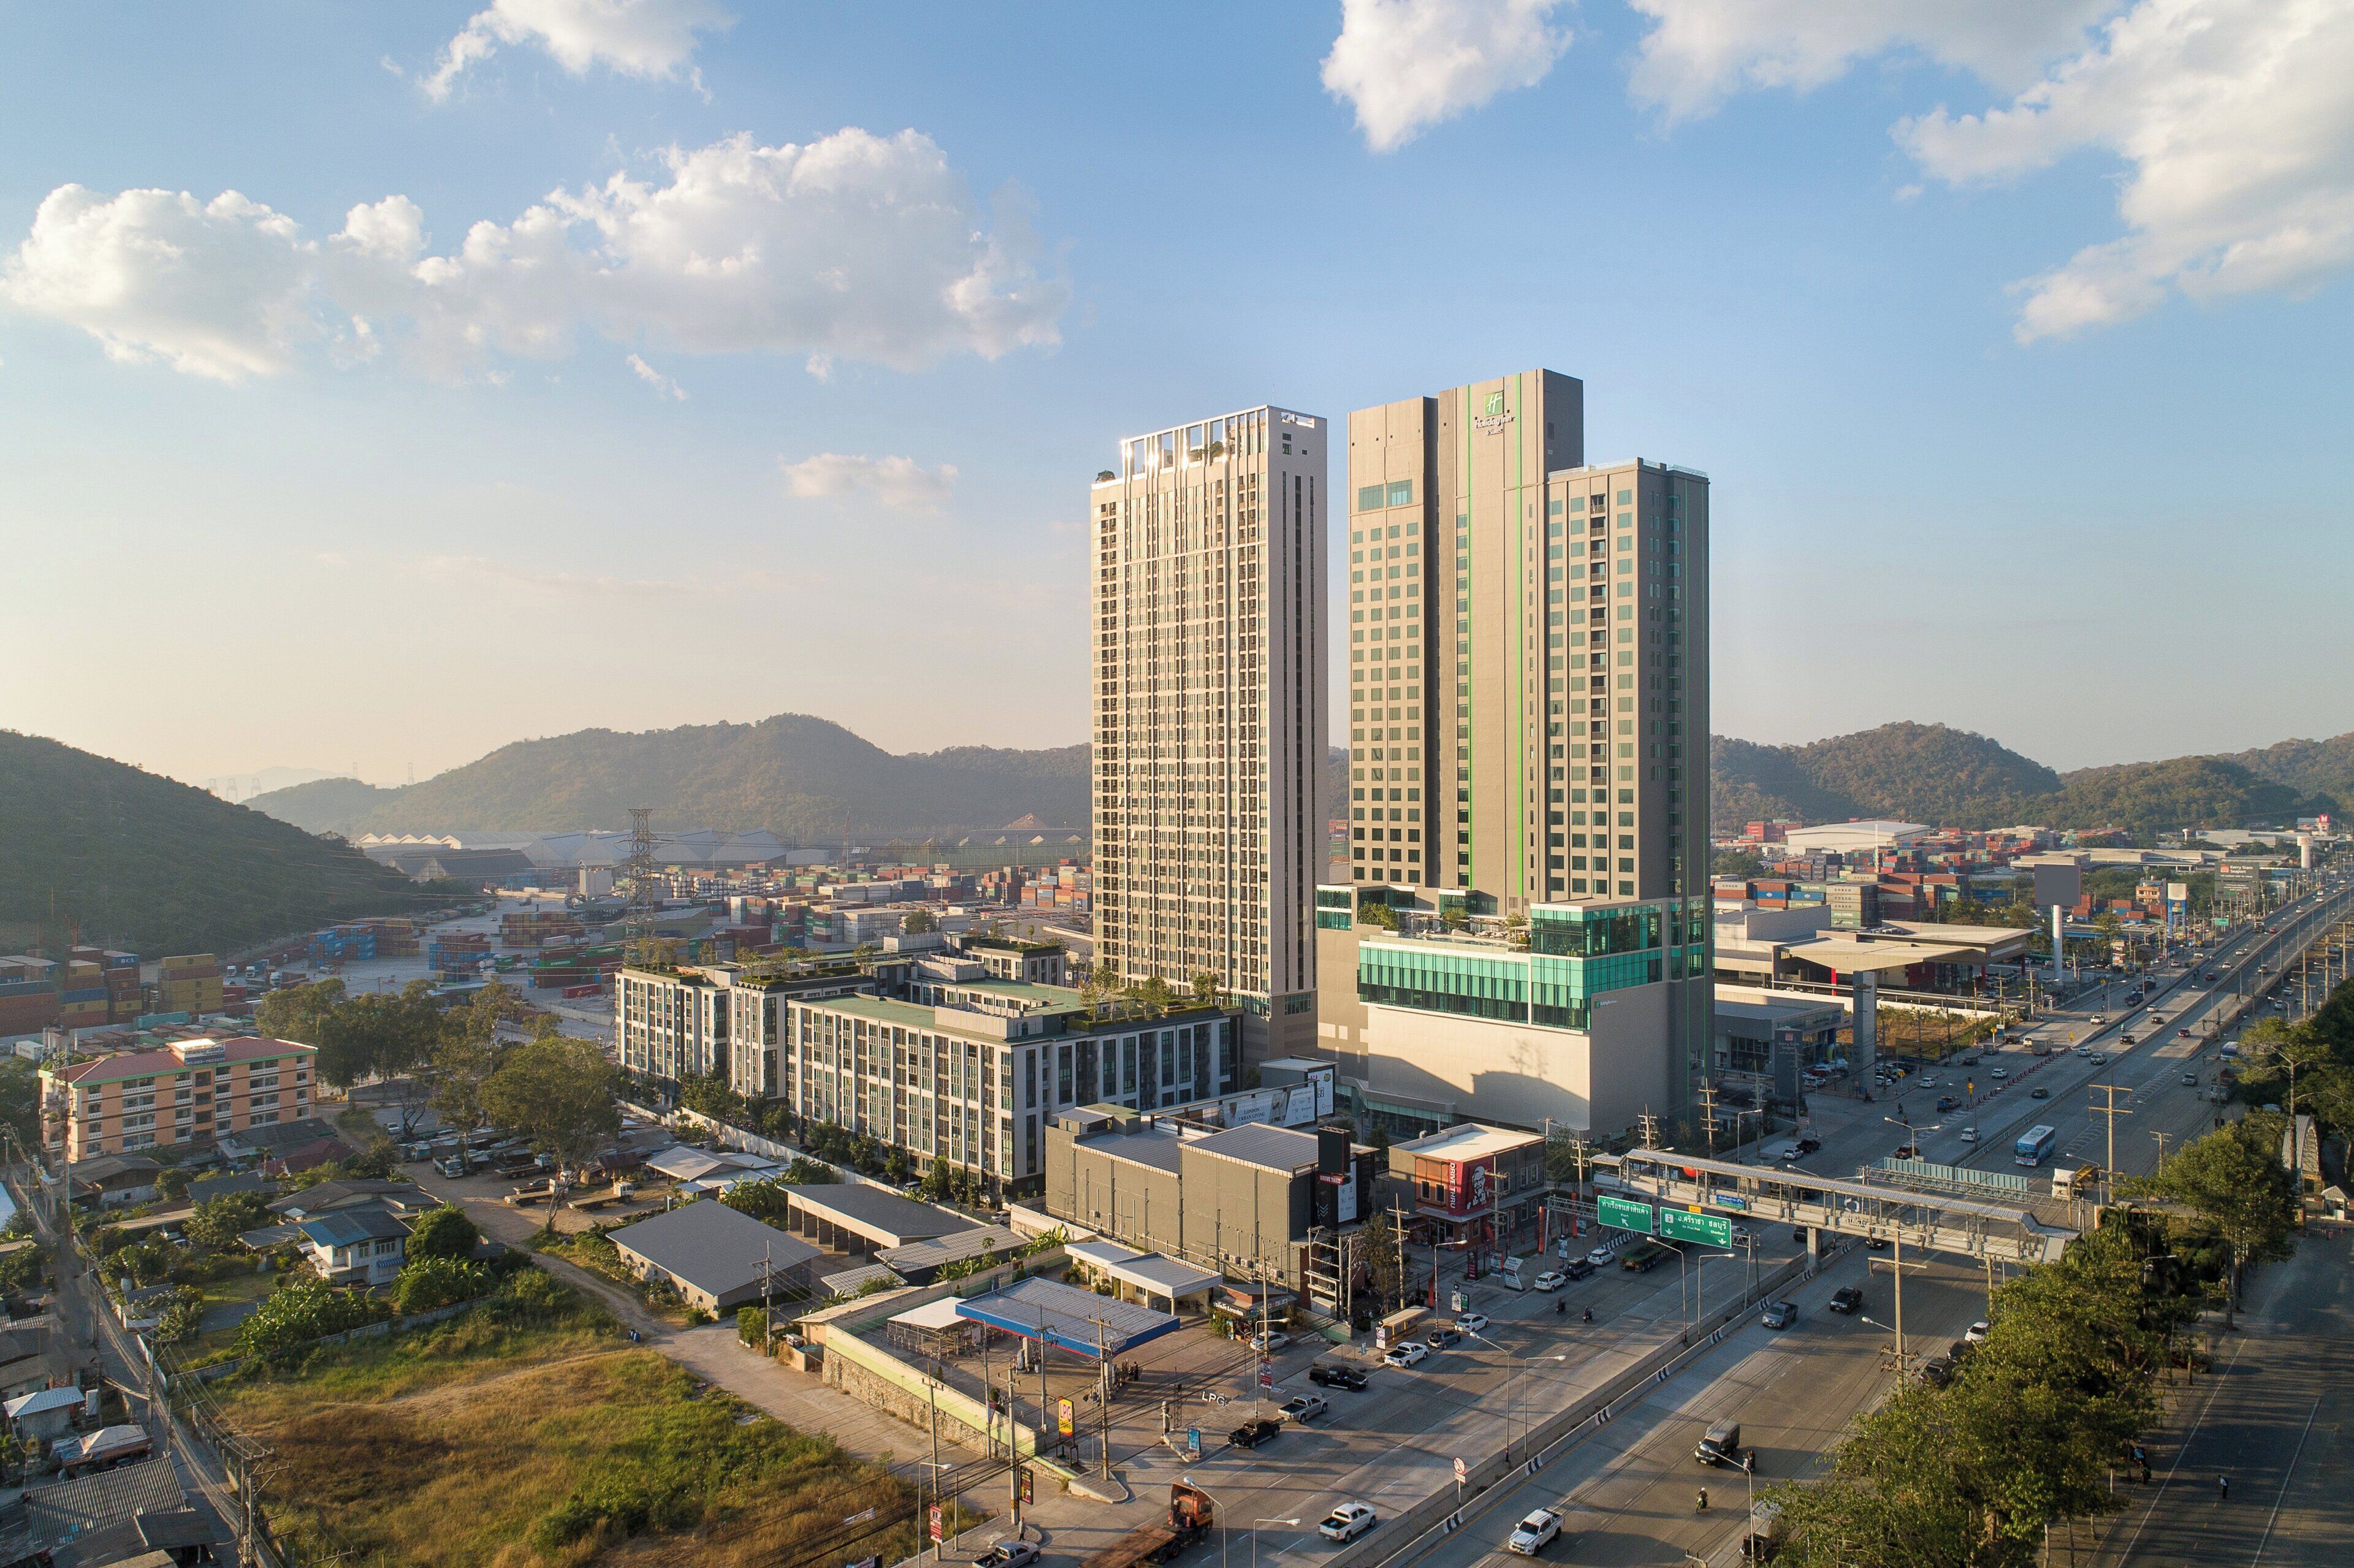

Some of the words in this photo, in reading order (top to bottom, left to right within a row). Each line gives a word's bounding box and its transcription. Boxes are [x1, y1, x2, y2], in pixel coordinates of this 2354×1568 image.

[1476, 417, 1501, 428] Holiday
[1501, 414, 1512, 424] Inn
[1602, 1199, 1648, 1215] ท่าเรือขนส่งสินค้า
[1678, 1215, 1704, 1225] อ.ศรีราชา
[1708, 1220, 1727, 1231] ชลบุรี
[1202, 1391, 1226, 1408] LPG
[1061, 1402, 1071, 1422] LPG
